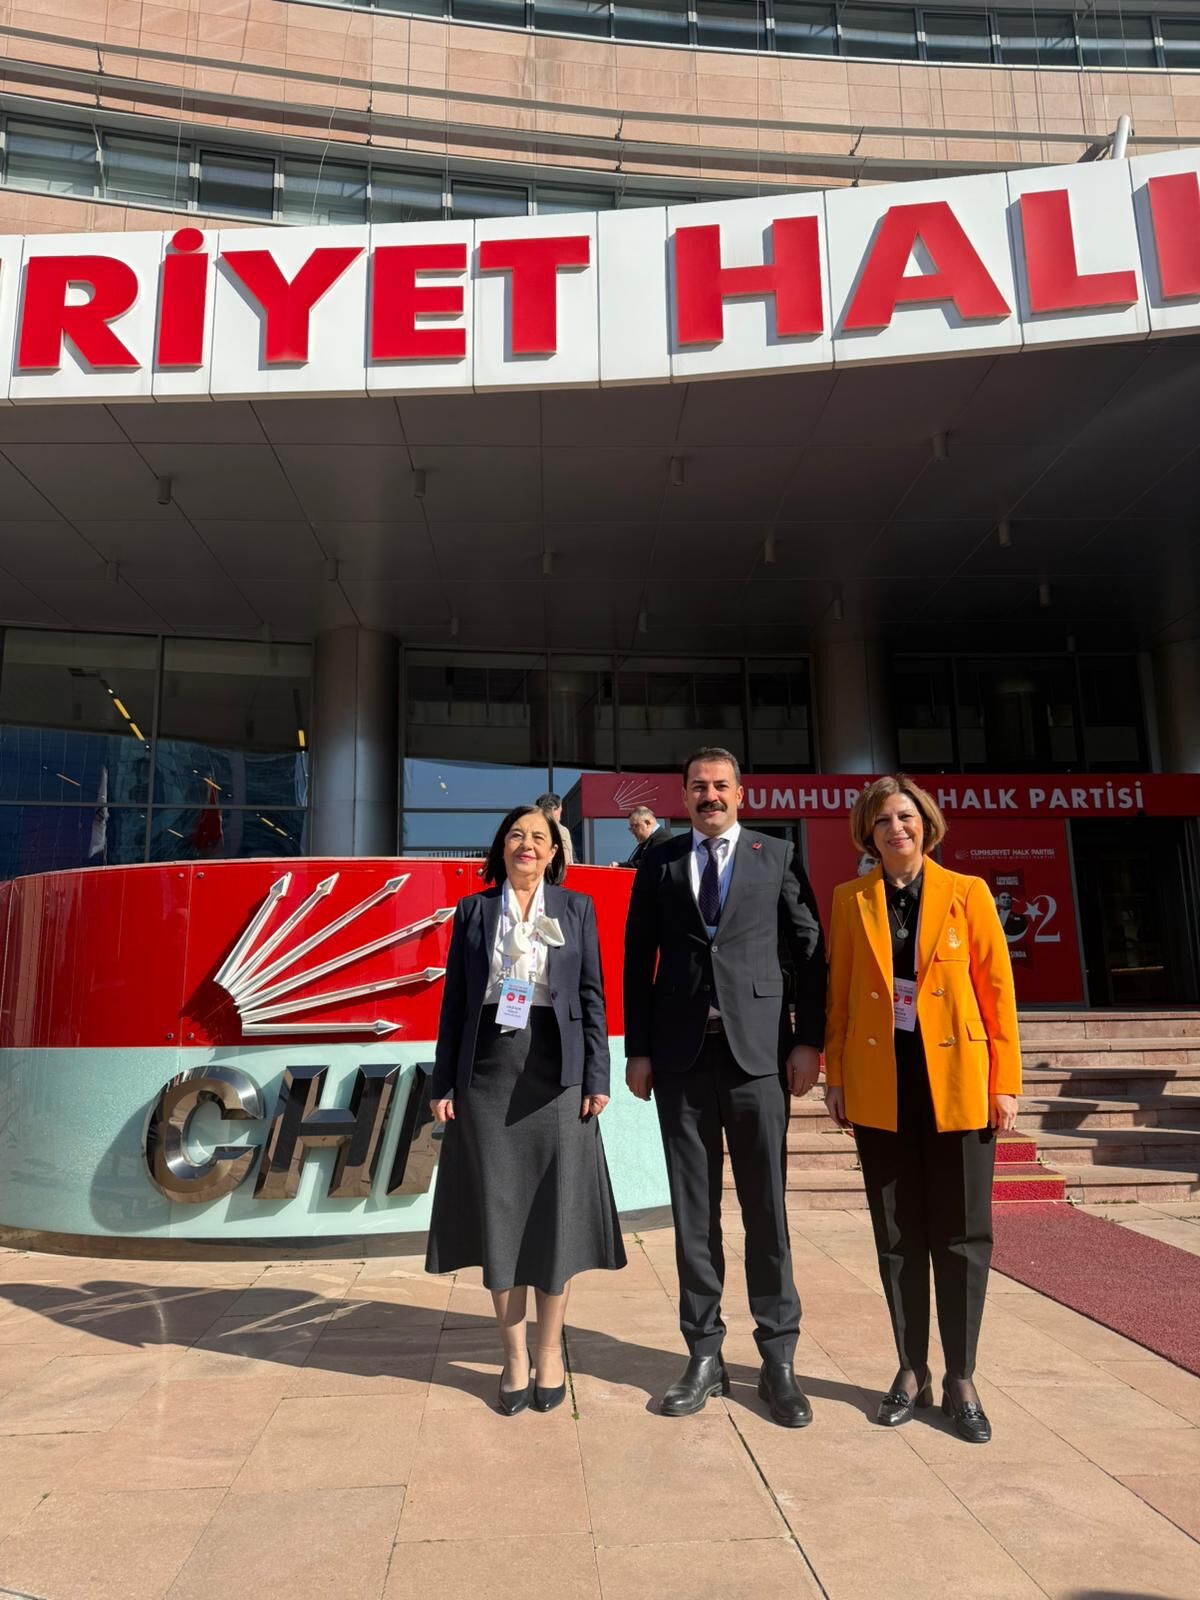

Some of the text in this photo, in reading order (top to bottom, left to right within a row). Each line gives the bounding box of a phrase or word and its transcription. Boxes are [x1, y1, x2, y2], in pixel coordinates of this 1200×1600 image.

[0, 227, 590, 369] RİYET
[737, 781, 1144, 809] UMHUR HALK PARTİSİ
